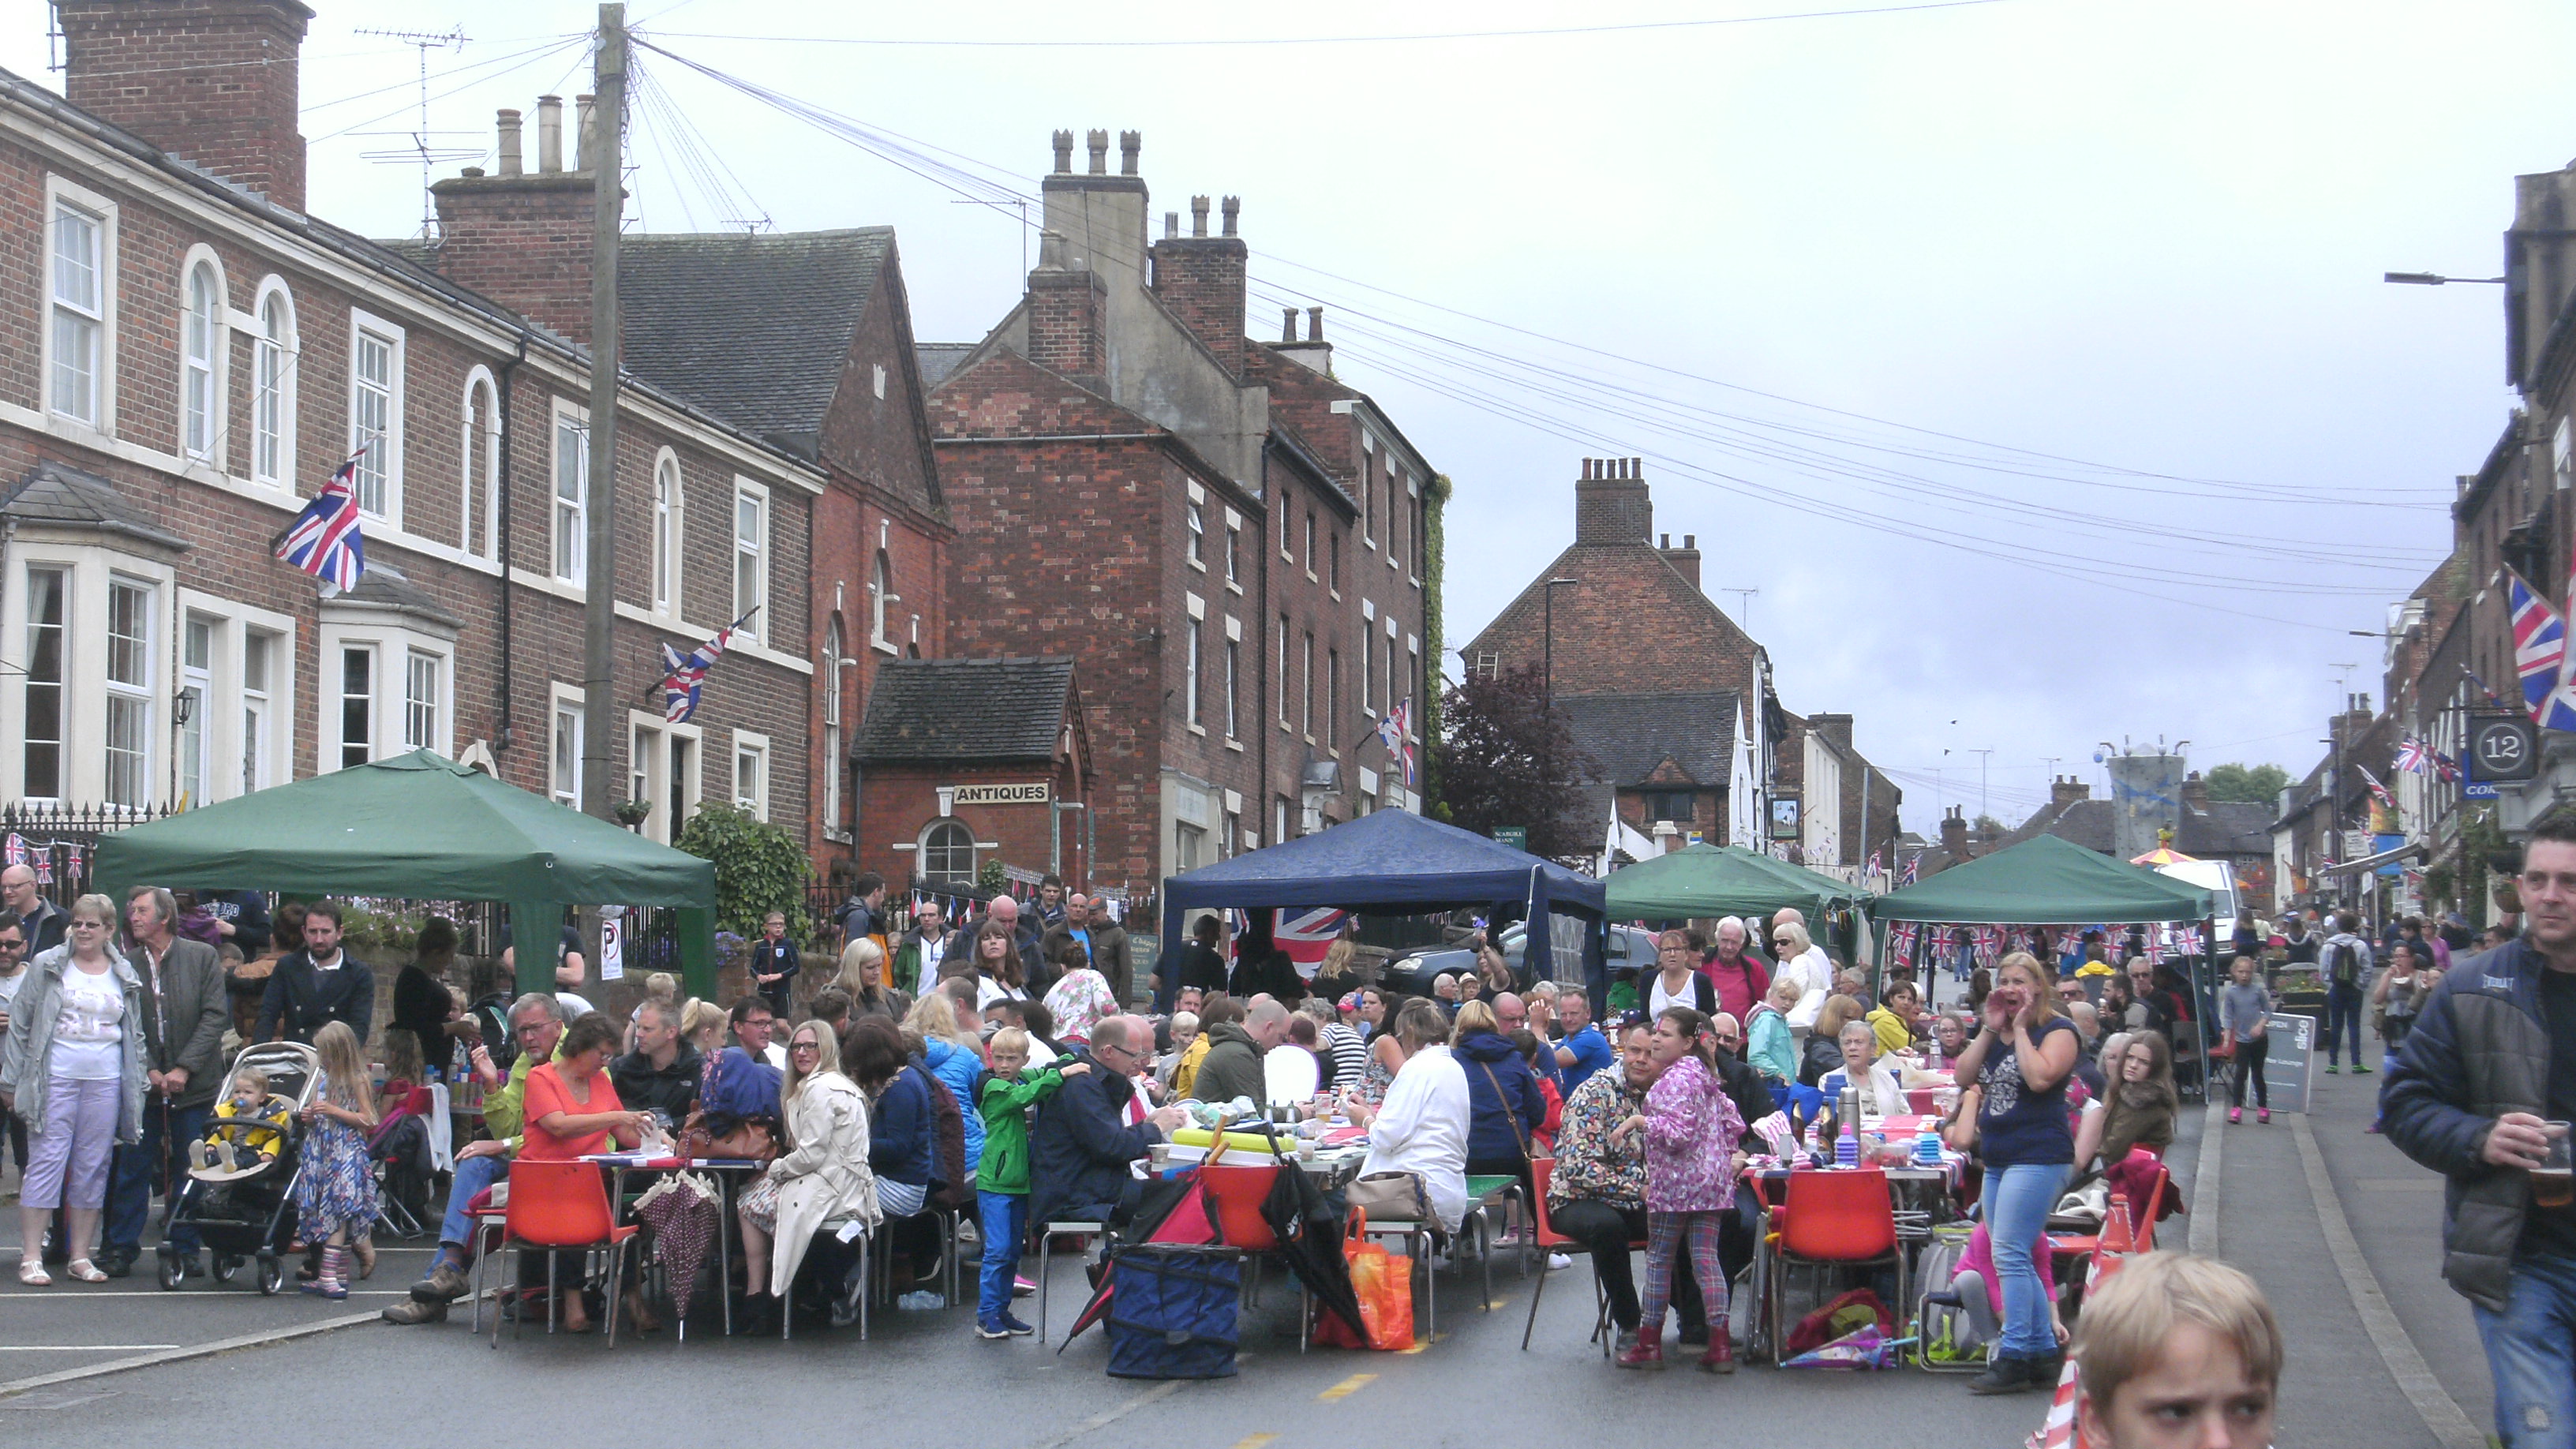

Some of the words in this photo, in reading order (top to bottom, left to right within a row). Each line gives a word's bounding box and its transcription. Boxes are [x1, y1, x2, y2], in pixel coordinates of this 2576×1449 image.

[2486, 736, 2520, 758] 12
[957, 787, 1046, 800] ANTIQUES
[2294, 1020, 2309, 1050] slice
